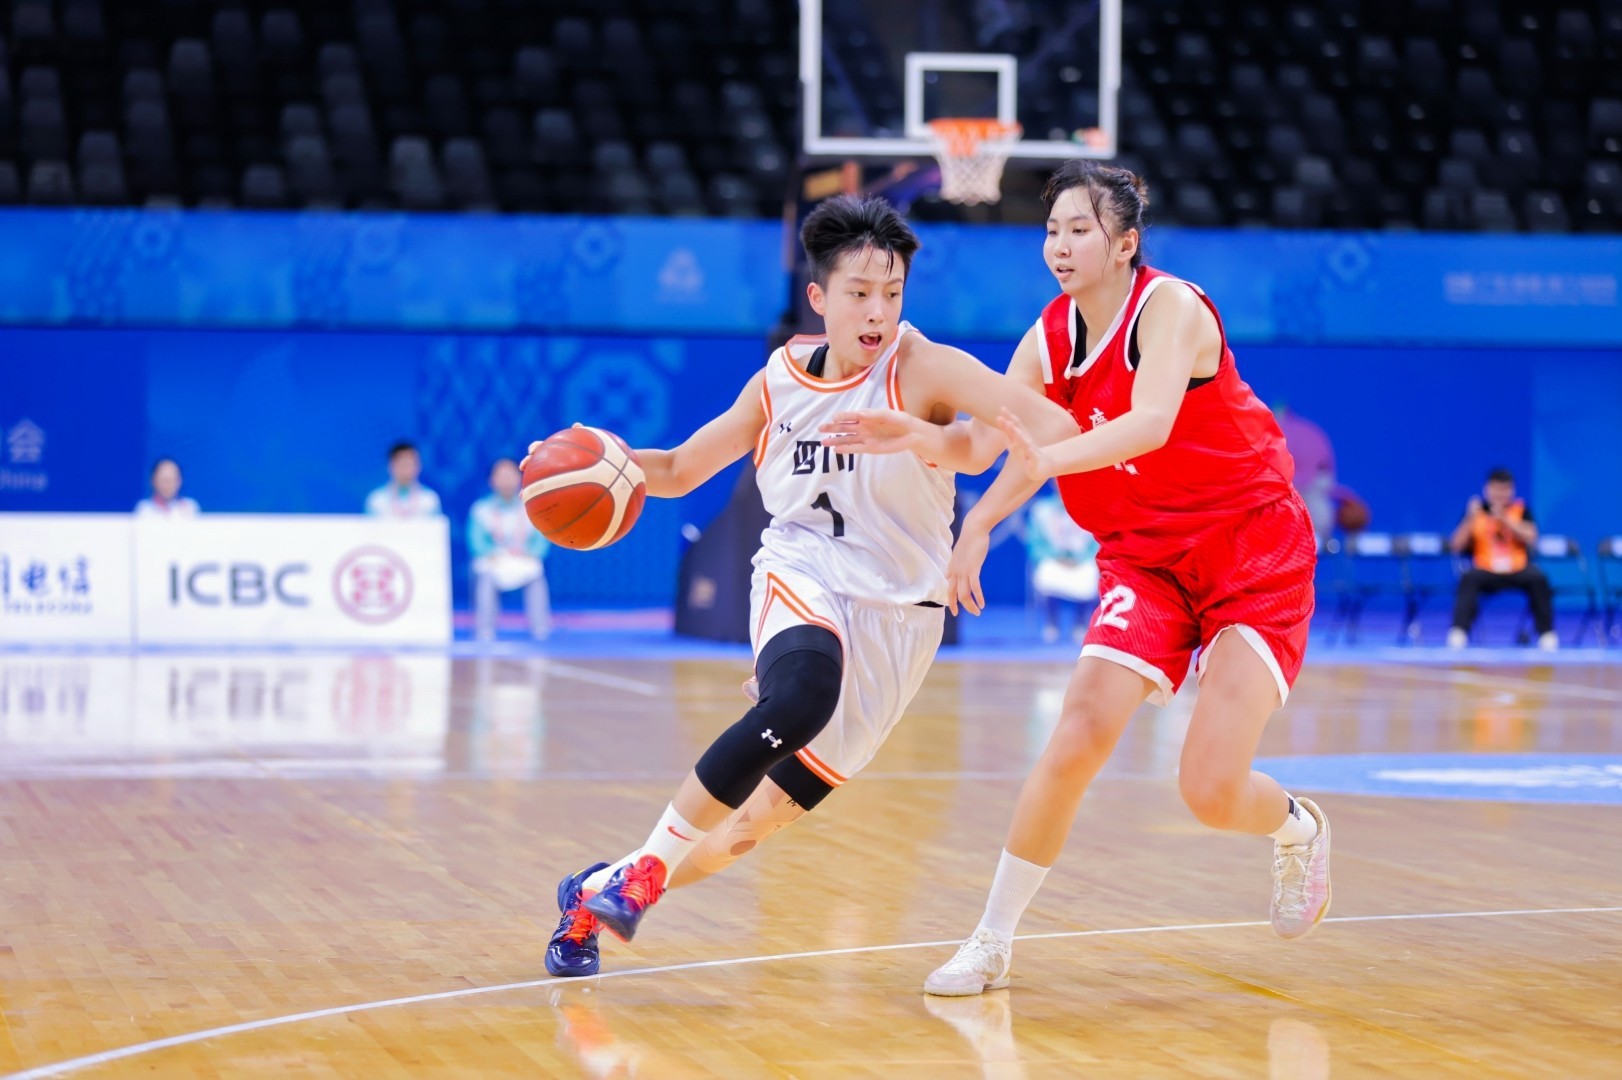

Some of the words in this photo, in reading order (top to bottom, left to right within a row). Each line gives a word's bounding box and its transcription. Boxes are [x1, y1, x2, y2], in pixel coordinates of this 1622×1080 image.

[810, 491, 845, 538] 1
[0, 553, 91, 599] 电信
[169, 563, 311, 608] ICBC
